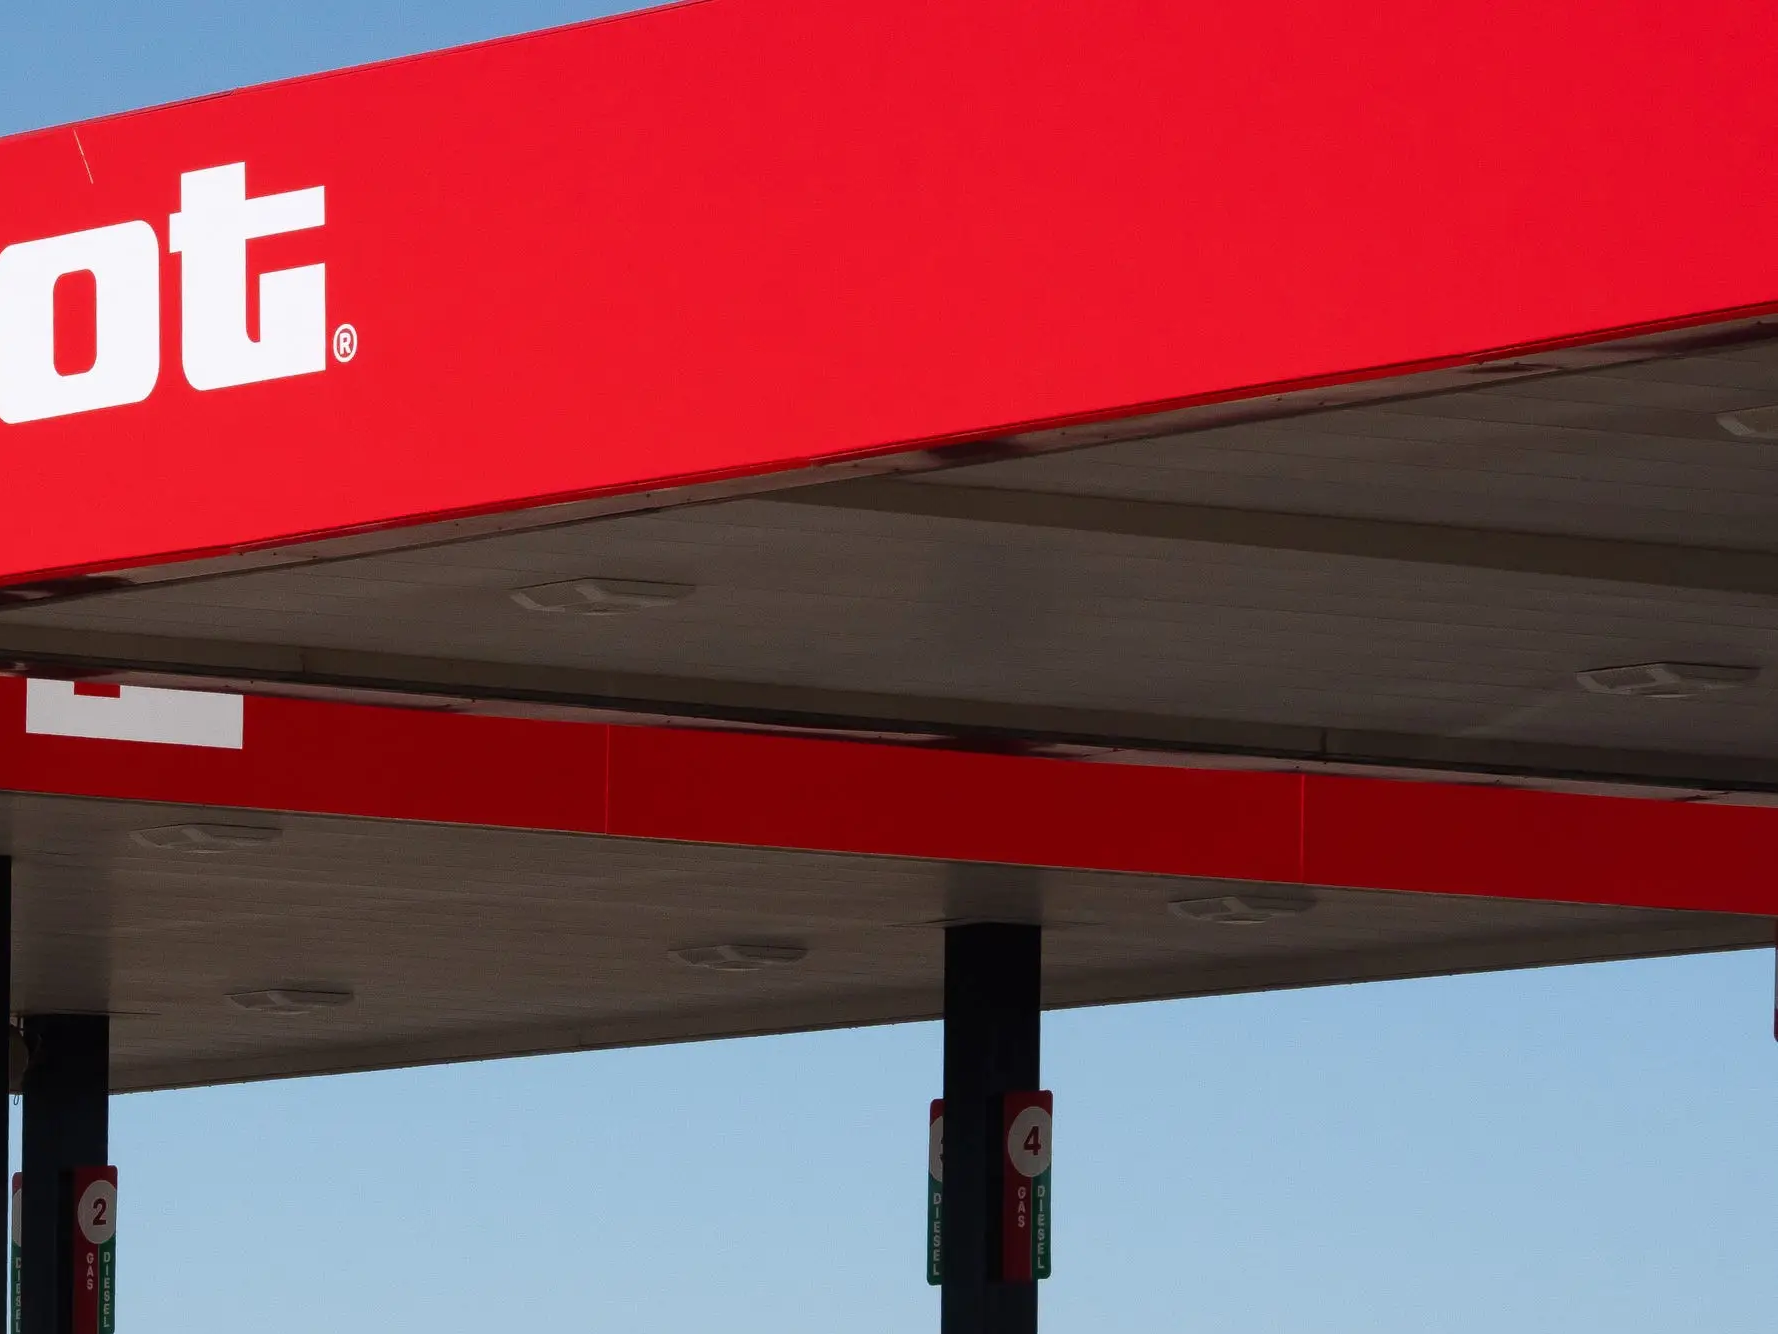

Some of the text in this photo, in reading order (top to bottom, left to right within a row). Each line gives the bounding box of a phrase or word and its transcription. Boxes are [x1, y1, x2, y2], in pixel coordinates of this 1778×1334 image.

[1024, 1125, 1042, 1156] 4
[92, 1198, 107, 1226] 2
[1017, 1186, 1026, 1228] GAS
[1037, 1185, 1046, 1269] DIESEL
[933, 1192, 942, 1276] DIESEL
[86, 1252, 94, 1290] GAS
[103, 1251, 111, 1328] DIESEL
